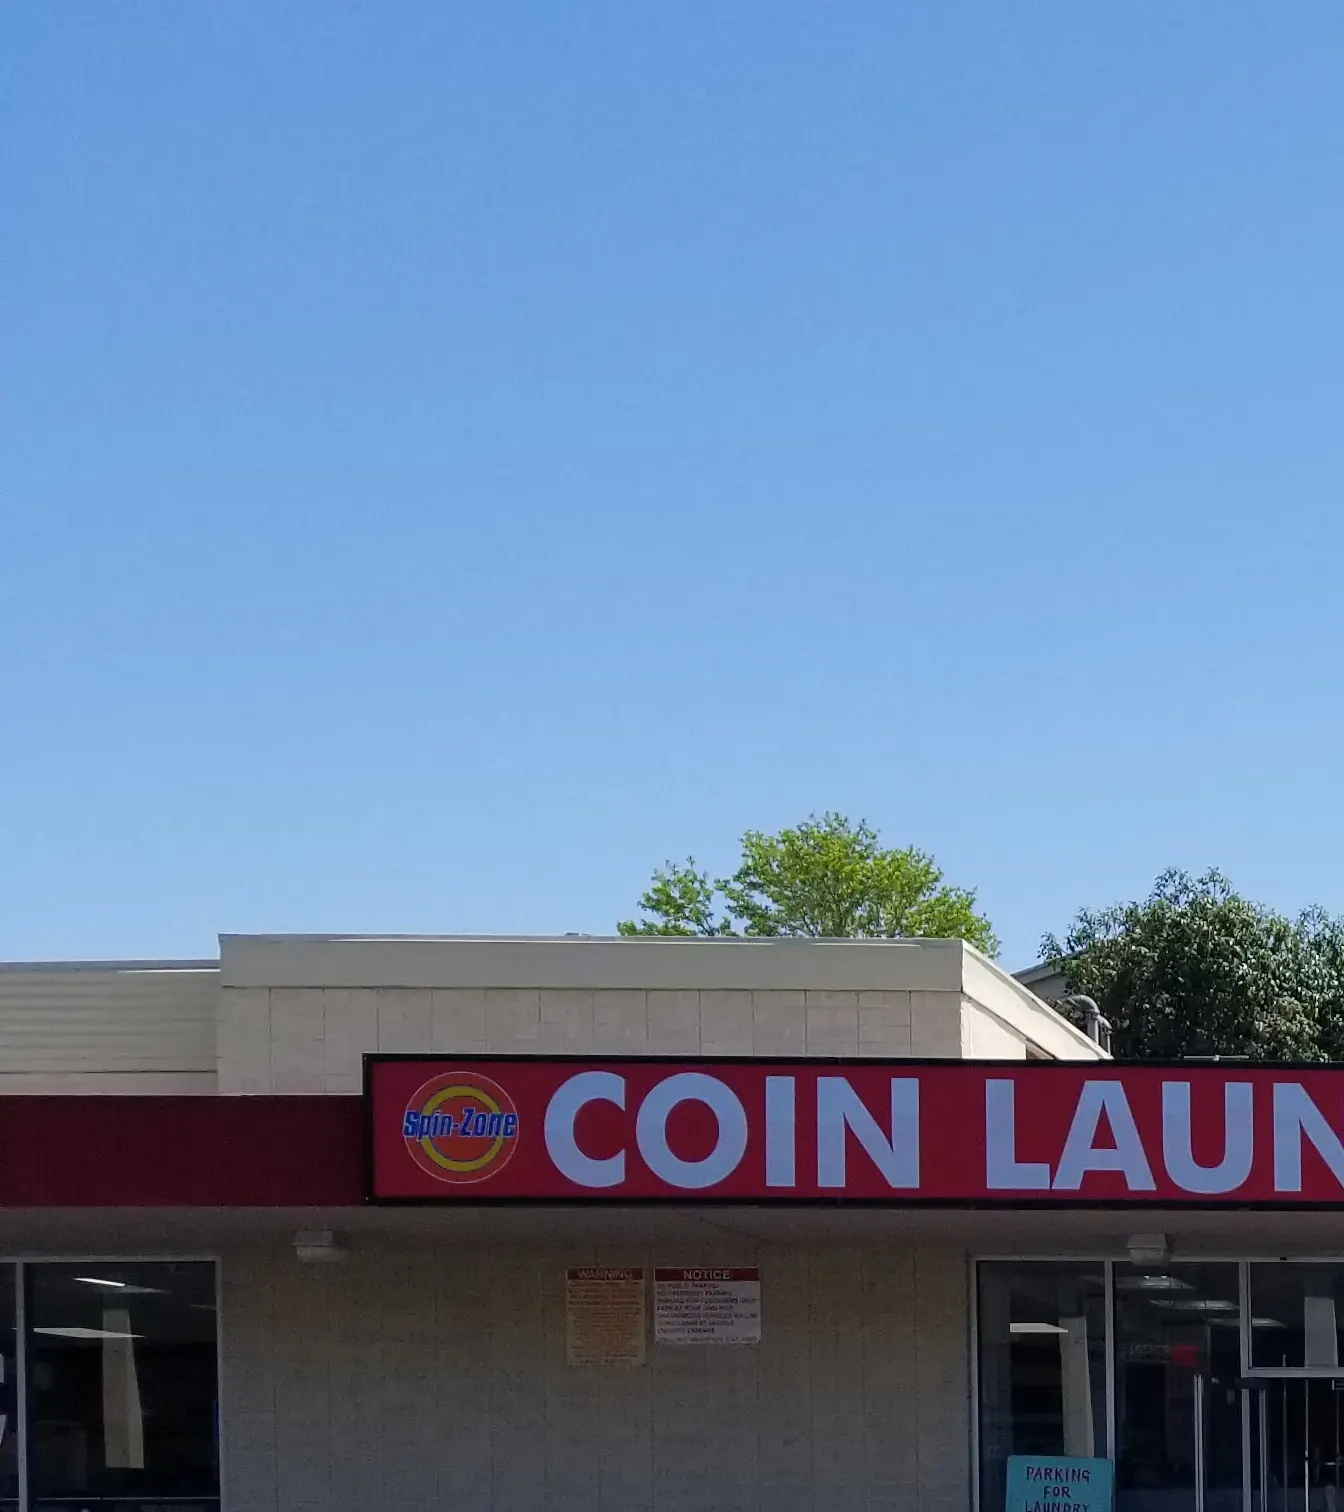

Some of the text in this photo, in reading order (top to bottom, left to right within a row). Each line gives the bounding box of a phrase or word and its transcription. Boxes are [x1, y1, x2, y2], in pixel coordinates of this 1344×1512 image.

[403, 1107, 519, 1142] Spin-Zone
[545, 1073, 919, 1187] COIN
[683, 1269, 731, 1280] NOTICE
[1026, 1466, 1091, 1483] PARKING
[1043, 1485, 1072, 1500] FOR
